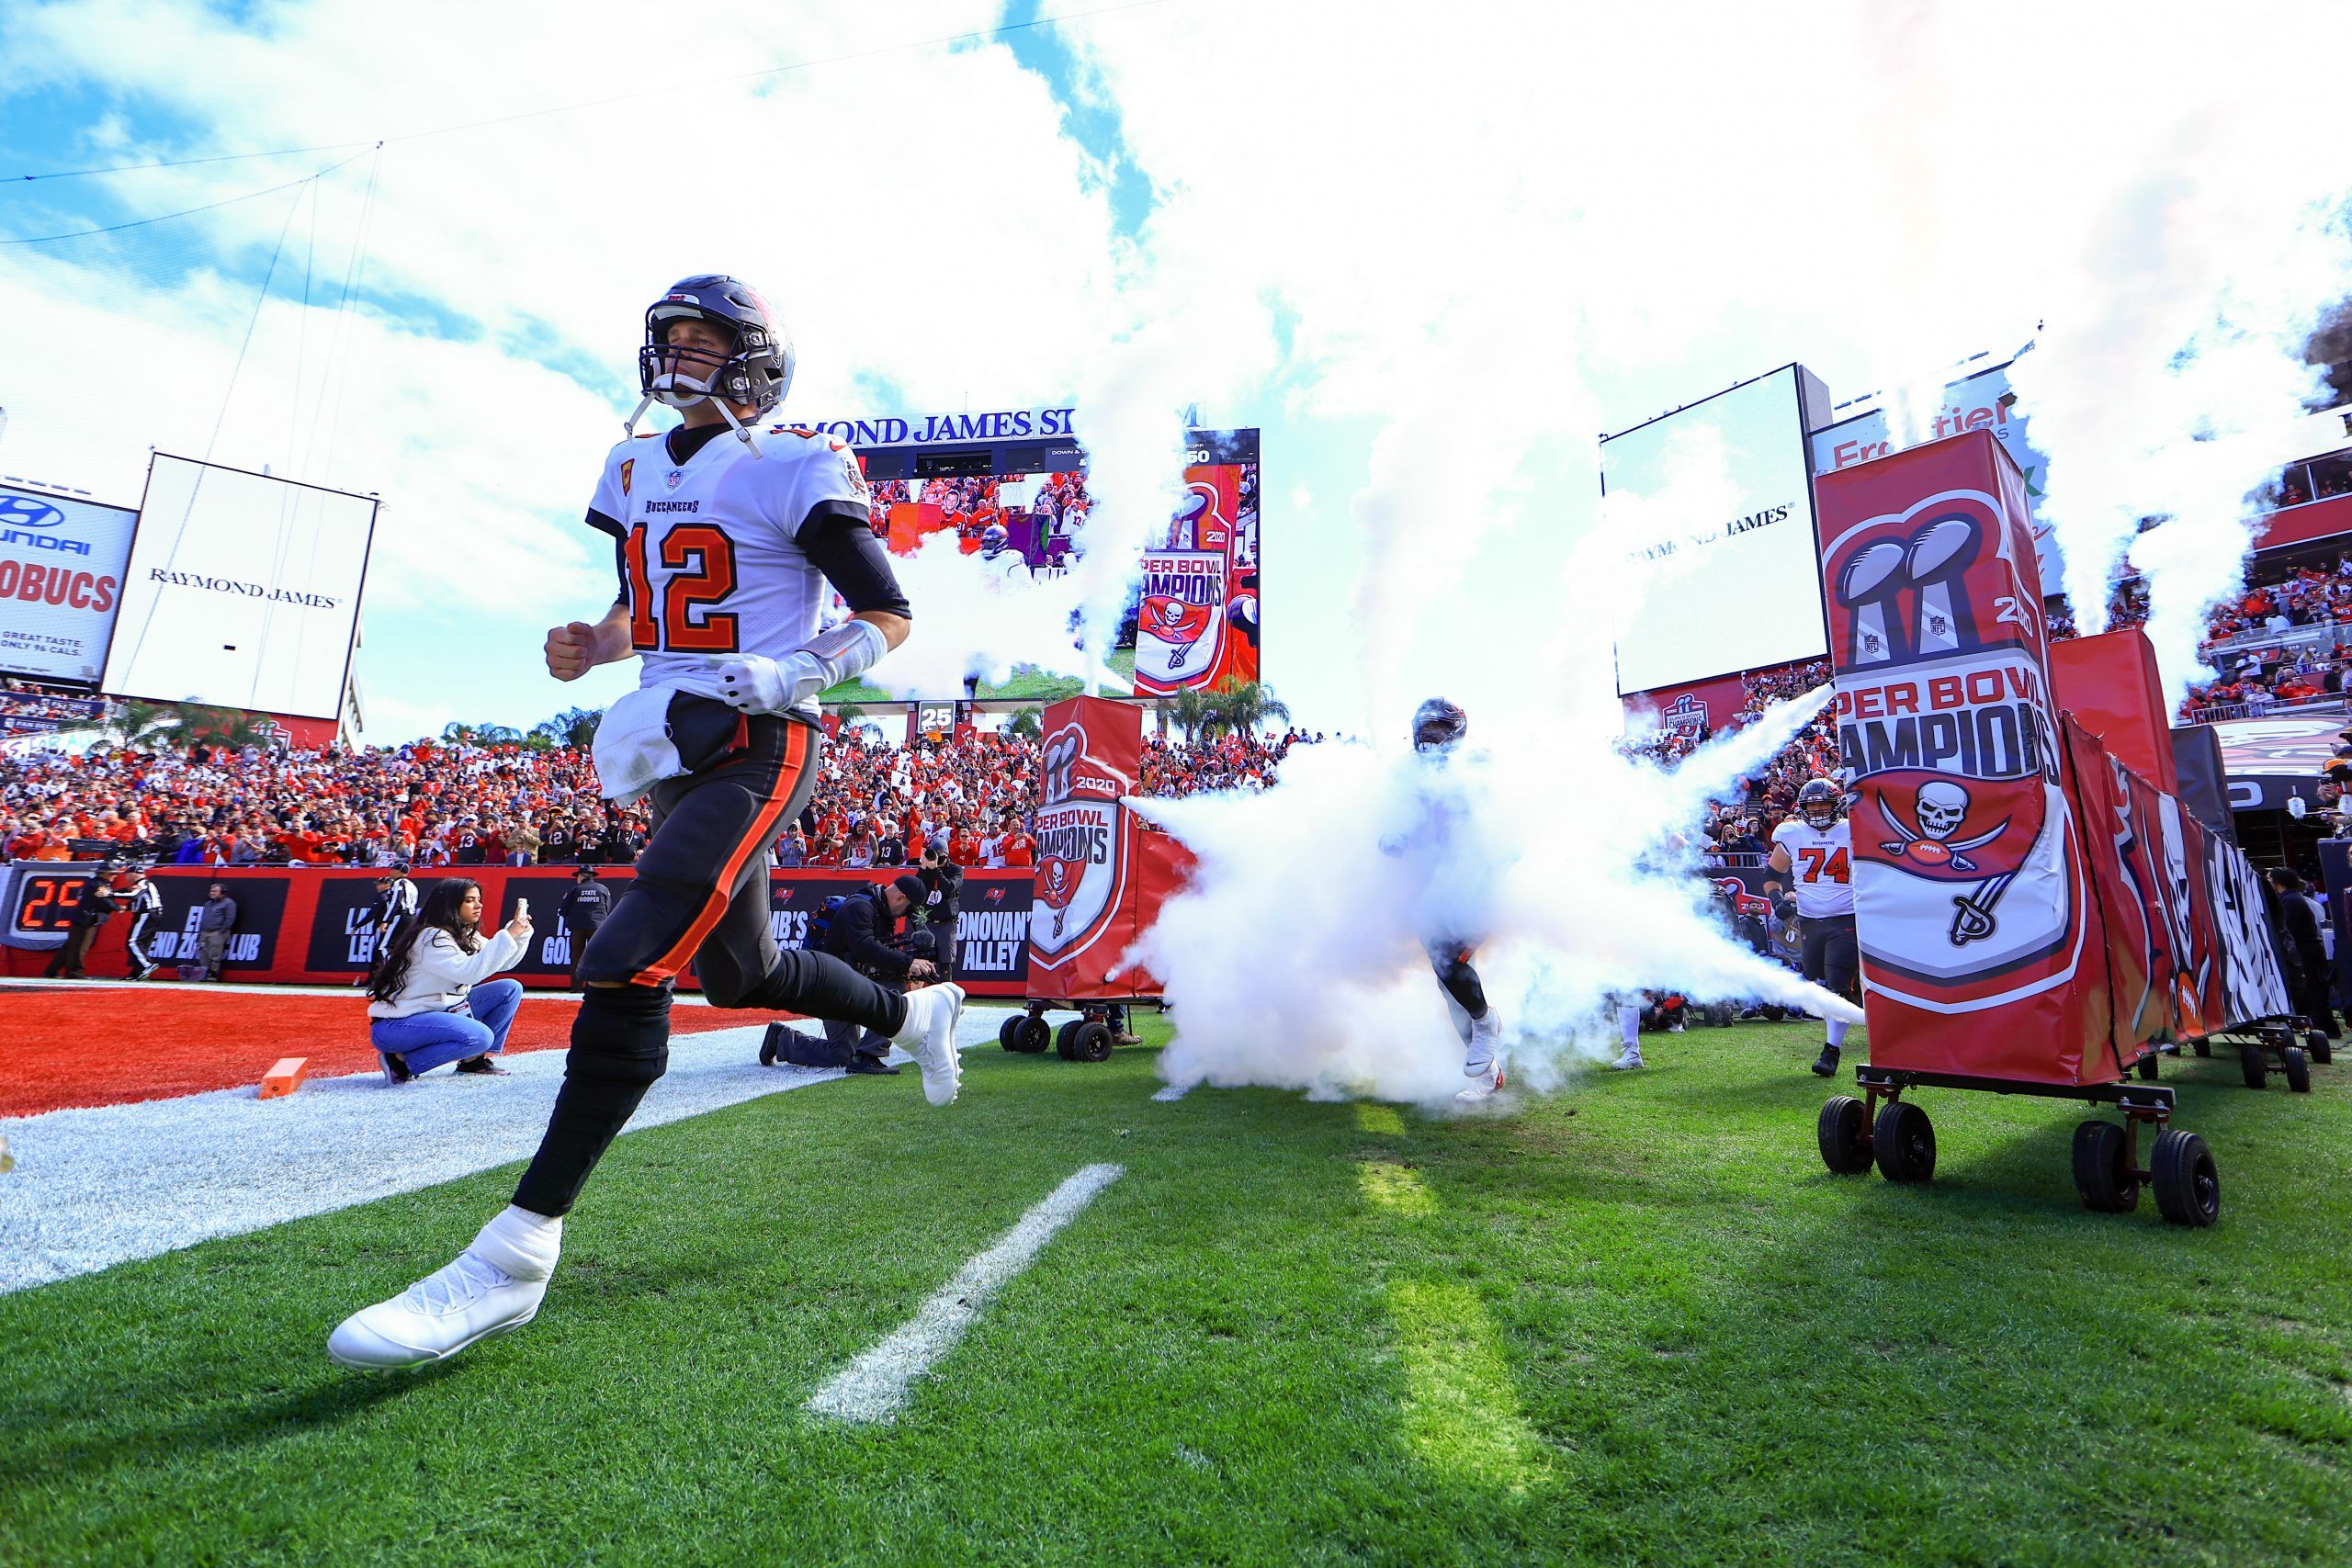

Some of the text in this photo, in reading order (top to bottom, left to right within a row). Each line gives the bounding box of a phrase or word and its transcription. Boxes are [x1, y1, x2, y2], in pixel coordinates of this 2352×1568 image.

[913, 411, 1032, 442] JAMES
[645, 500, 698, 514] BUCCANEERS
[1177, 560, 1221, 574] BOWL
[149, 568, 335, 609] RAYMOND JAMES
[626, 522, 740, 653] 12
[0, 639, 82, 657] ONLY 96 CALS.
[3, 631, 84, 649] GREAT TASTE.
[1928, 667, 2044, 710] BOWL
[922, 708, 952, 727] 25
[1076, 776, 1116, 792] 2020
[1060, 809, 1108, 829] BOWL
[881, 846, 891, 858] 13
[1798, 847, 1850, 884] 74
[962, 941, 1022, 971] ALLEY
